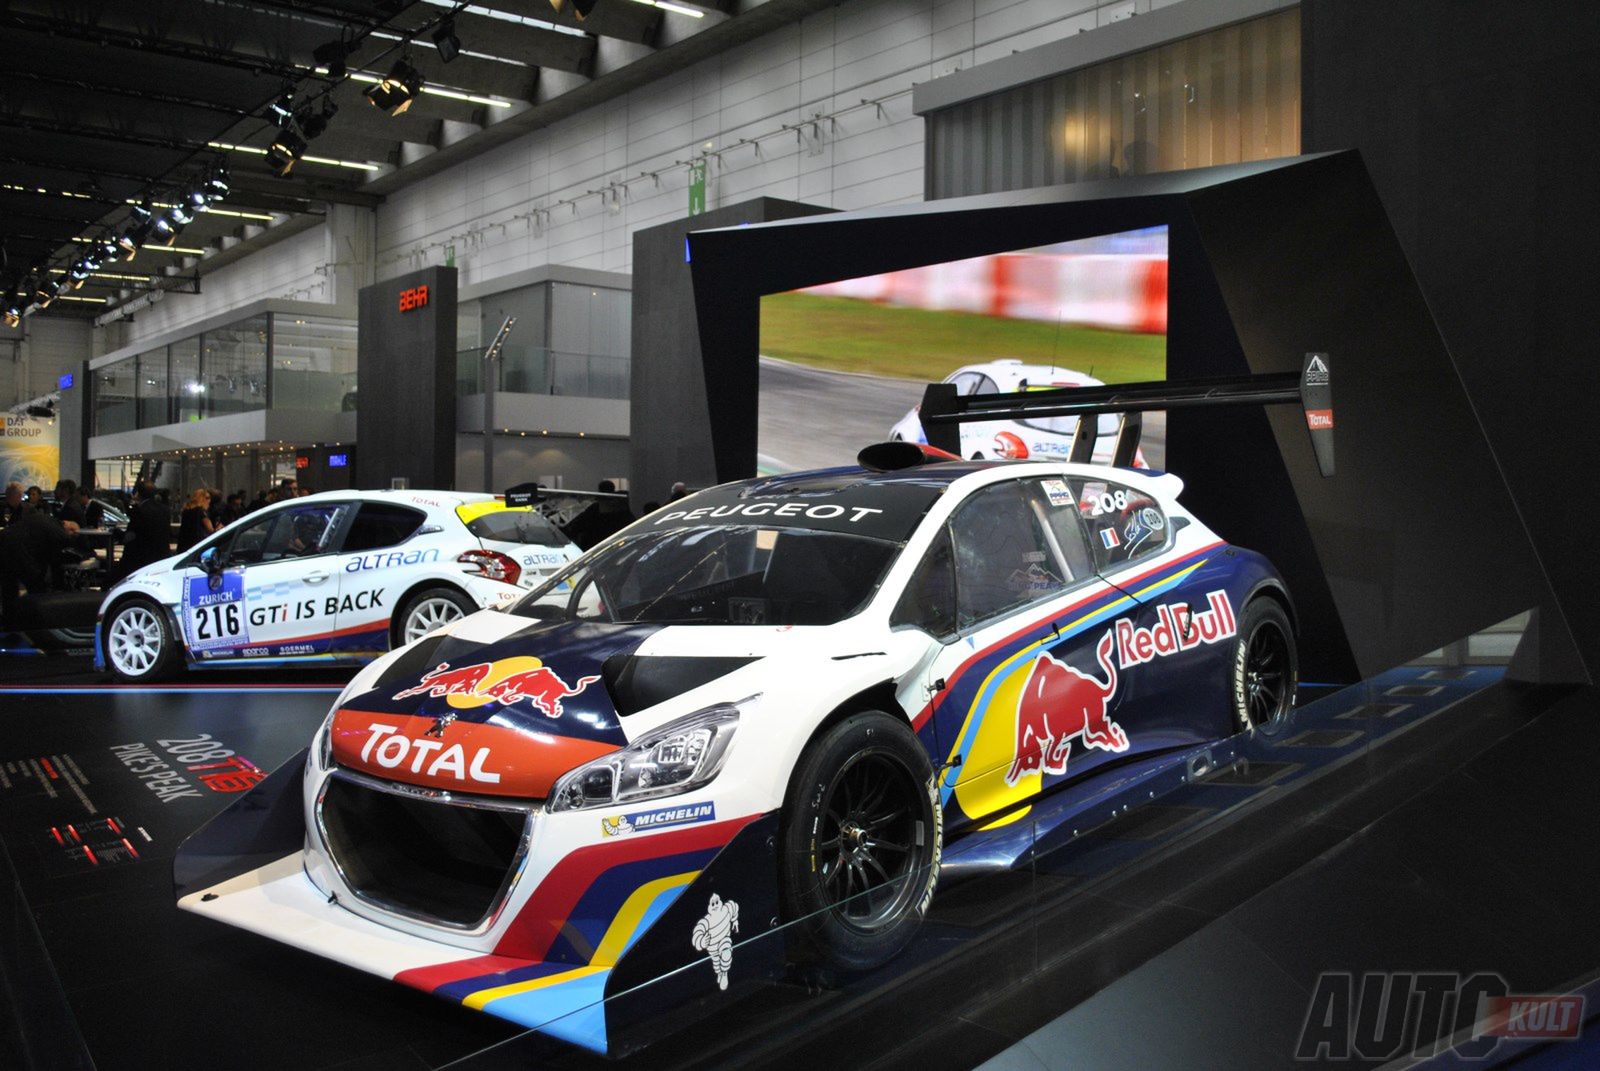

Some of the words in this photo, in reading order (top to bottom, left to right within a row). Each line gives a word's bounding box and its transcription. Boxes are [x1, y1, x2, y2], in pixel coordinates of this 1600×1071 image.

[399, 284, 428, 311] BEHR
[7, 428, 41, 437] GROUP
[1309, 413, 1331, 425] TOTAL
[411, 496, 440, 507] TOTAL
[655, 503, 883, 525] PEUGEOT
[1088, 490, 1127, 515] 208
[199, 591, 233, 605] ZURICH
[249, 603, 288, 626] GTi
[295, 601, 316, 620] IS
[324, 588, 385, 616] BACK
[196, 604, 240, 640] 216
[1115, 604, 1178, 669] Red
[1169, 589, 1237, 651] Bull
[1235, 640, 1247, 722] MICHELIN
[156, 733, 235, 763] 208
[361, 723, 500, 784] TOTAL
[140, 764, 203, 802] PEAK
[635, 805, 712, 826] MICHELIN
